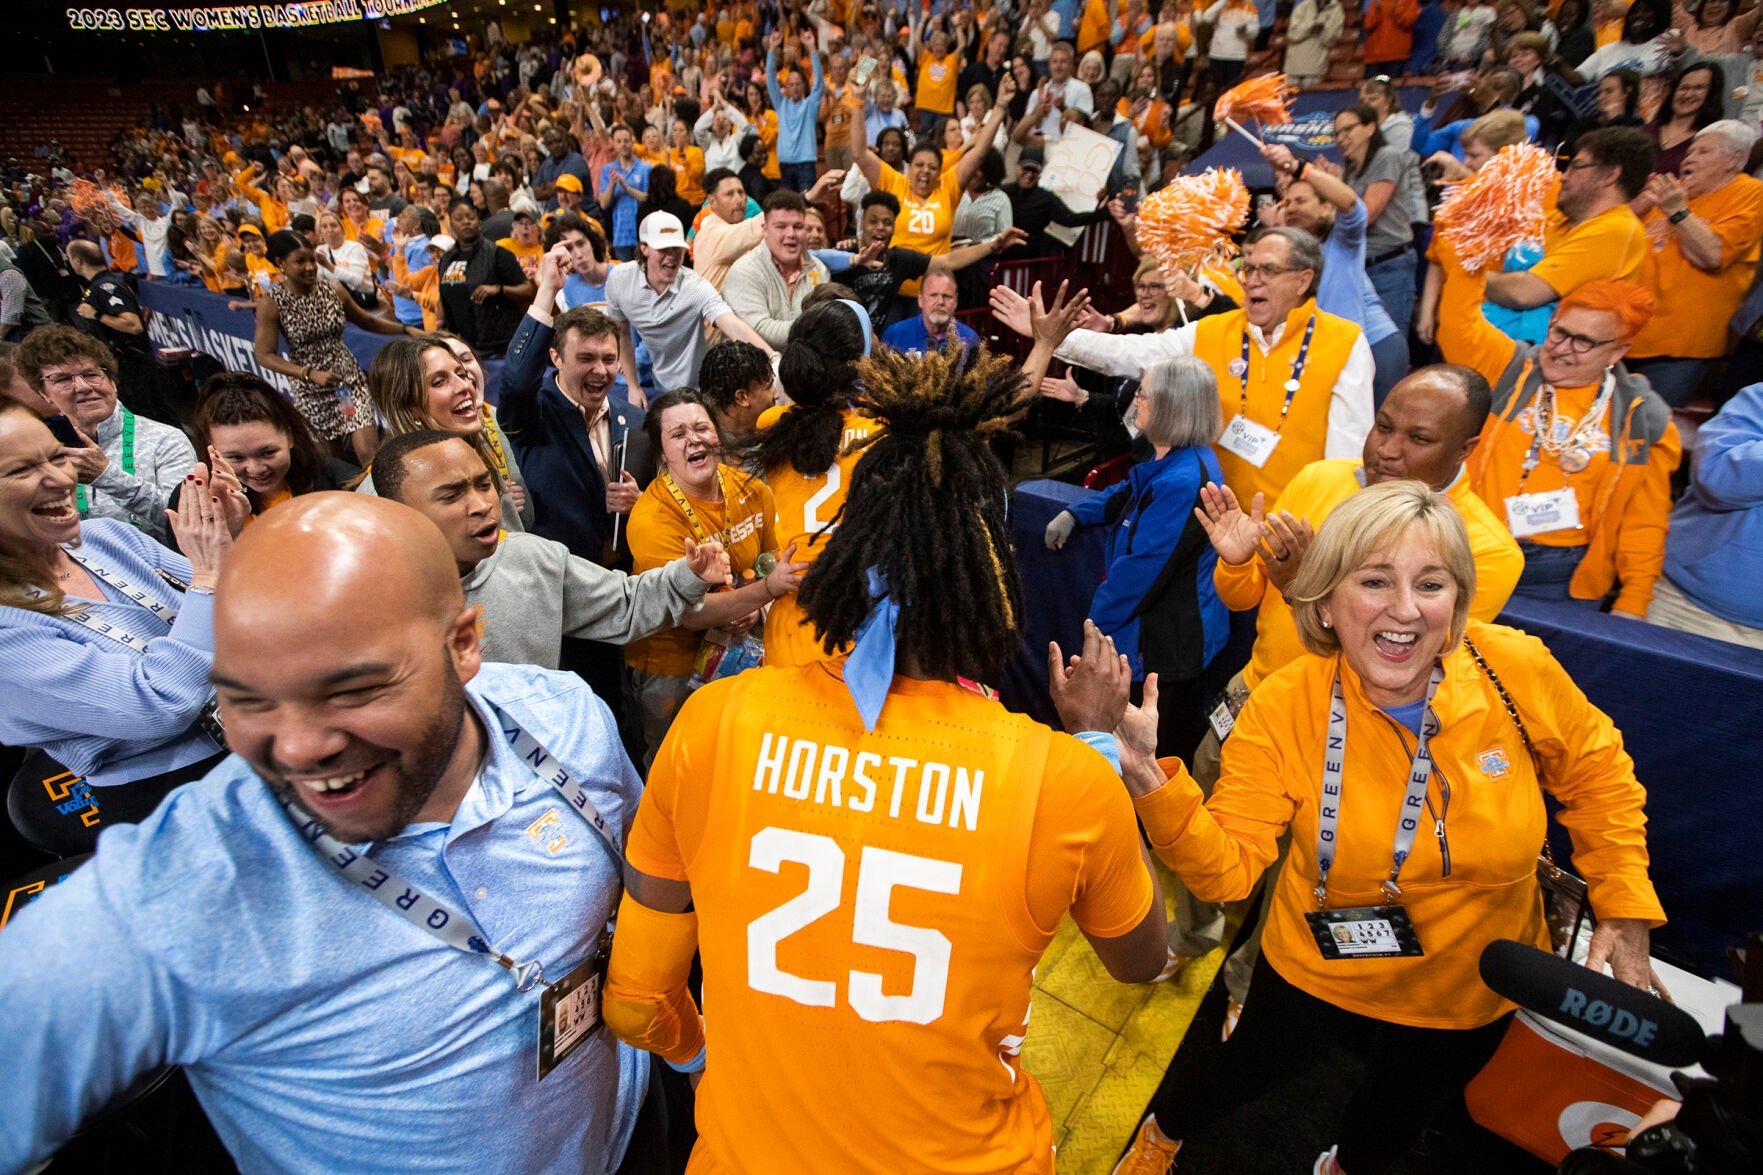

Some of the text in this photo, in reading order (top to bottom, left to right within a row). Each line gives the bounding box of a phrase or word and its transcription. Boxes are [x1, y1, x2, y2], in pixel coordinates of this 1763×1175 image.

[66, 8, 125, 30] 2023
[126, 9, 171, 30] SEC
[169, 5, 262, 31] WOMEN'S
[260, 0, 363, 28] BASKETBALL
[907, 208, 935, 234] 20
[1531, 502, 1554, 514] VIP
[752, 732, 985, 831] HORSTON
[747, 826, 963, 1026] 25
[1560, 986, 1659, 1047] RØDE
